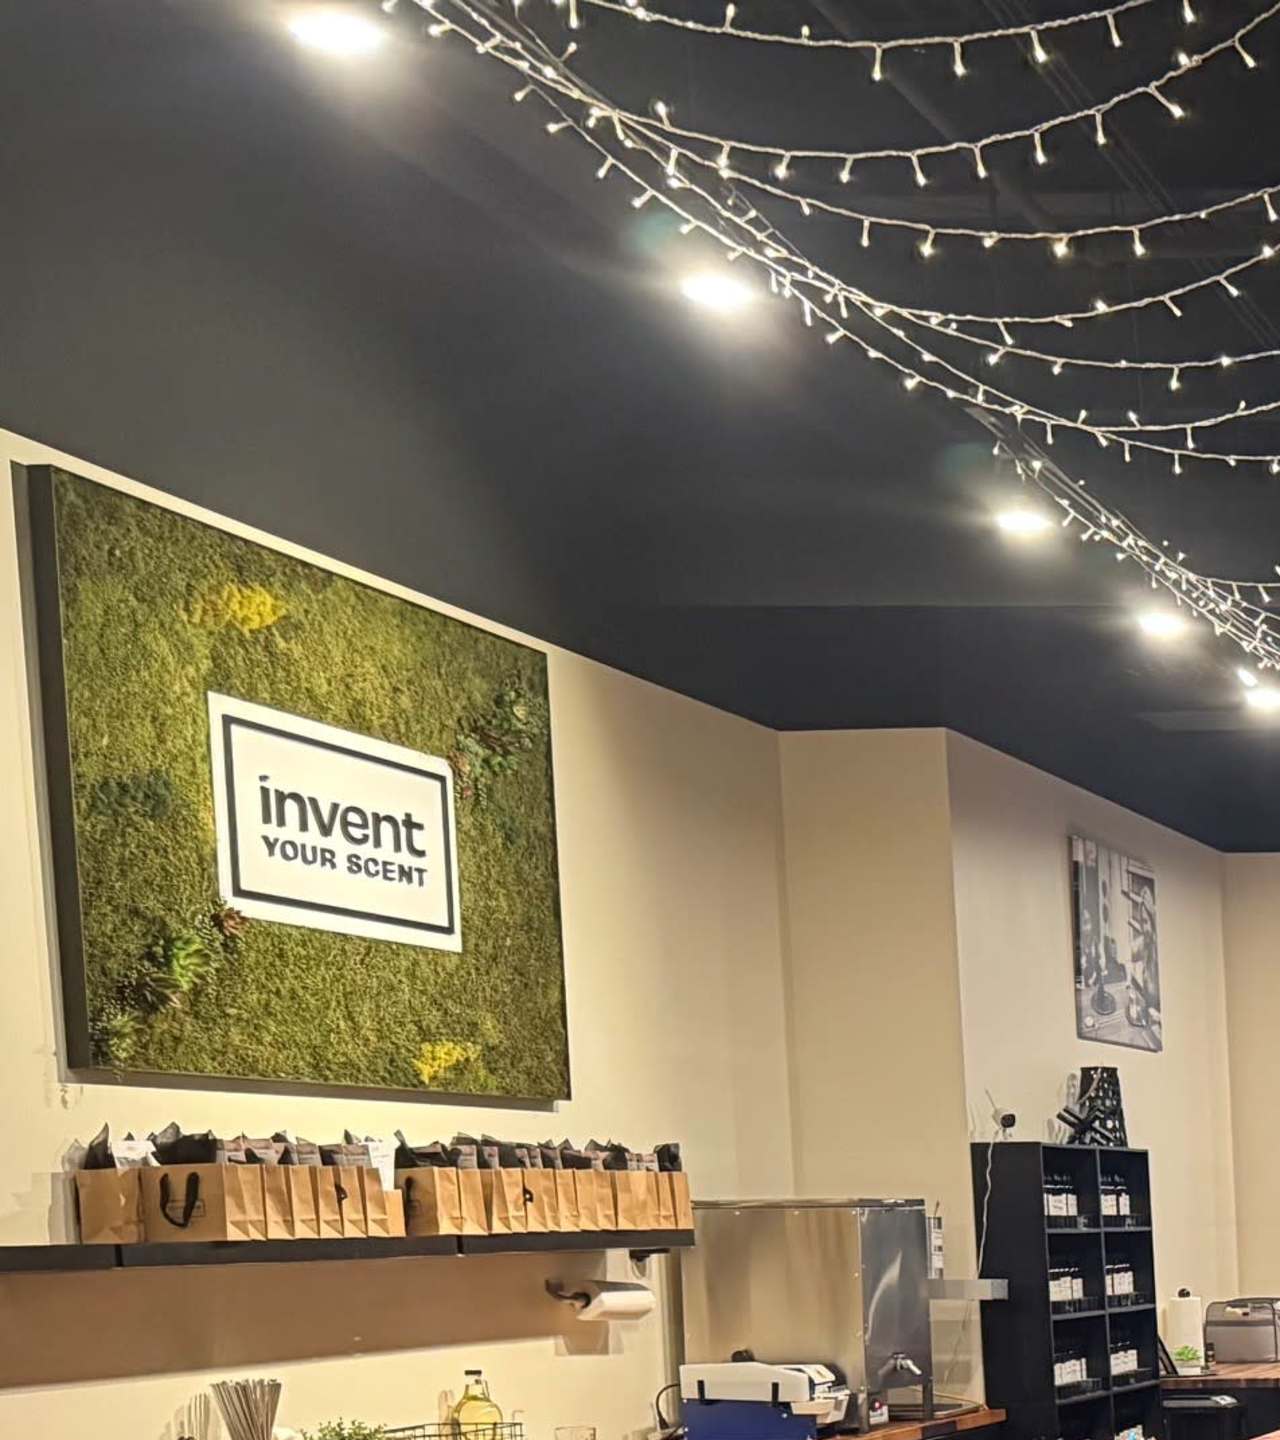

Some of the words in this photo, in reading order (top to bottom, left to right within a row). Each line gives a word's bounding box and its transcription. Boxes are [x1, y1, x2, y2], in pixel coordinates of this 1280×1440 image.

[258, 774, 427, 858] invent
[261, 835, 337, 870] YOUR
[346, 853, 428, 888] SCENT
